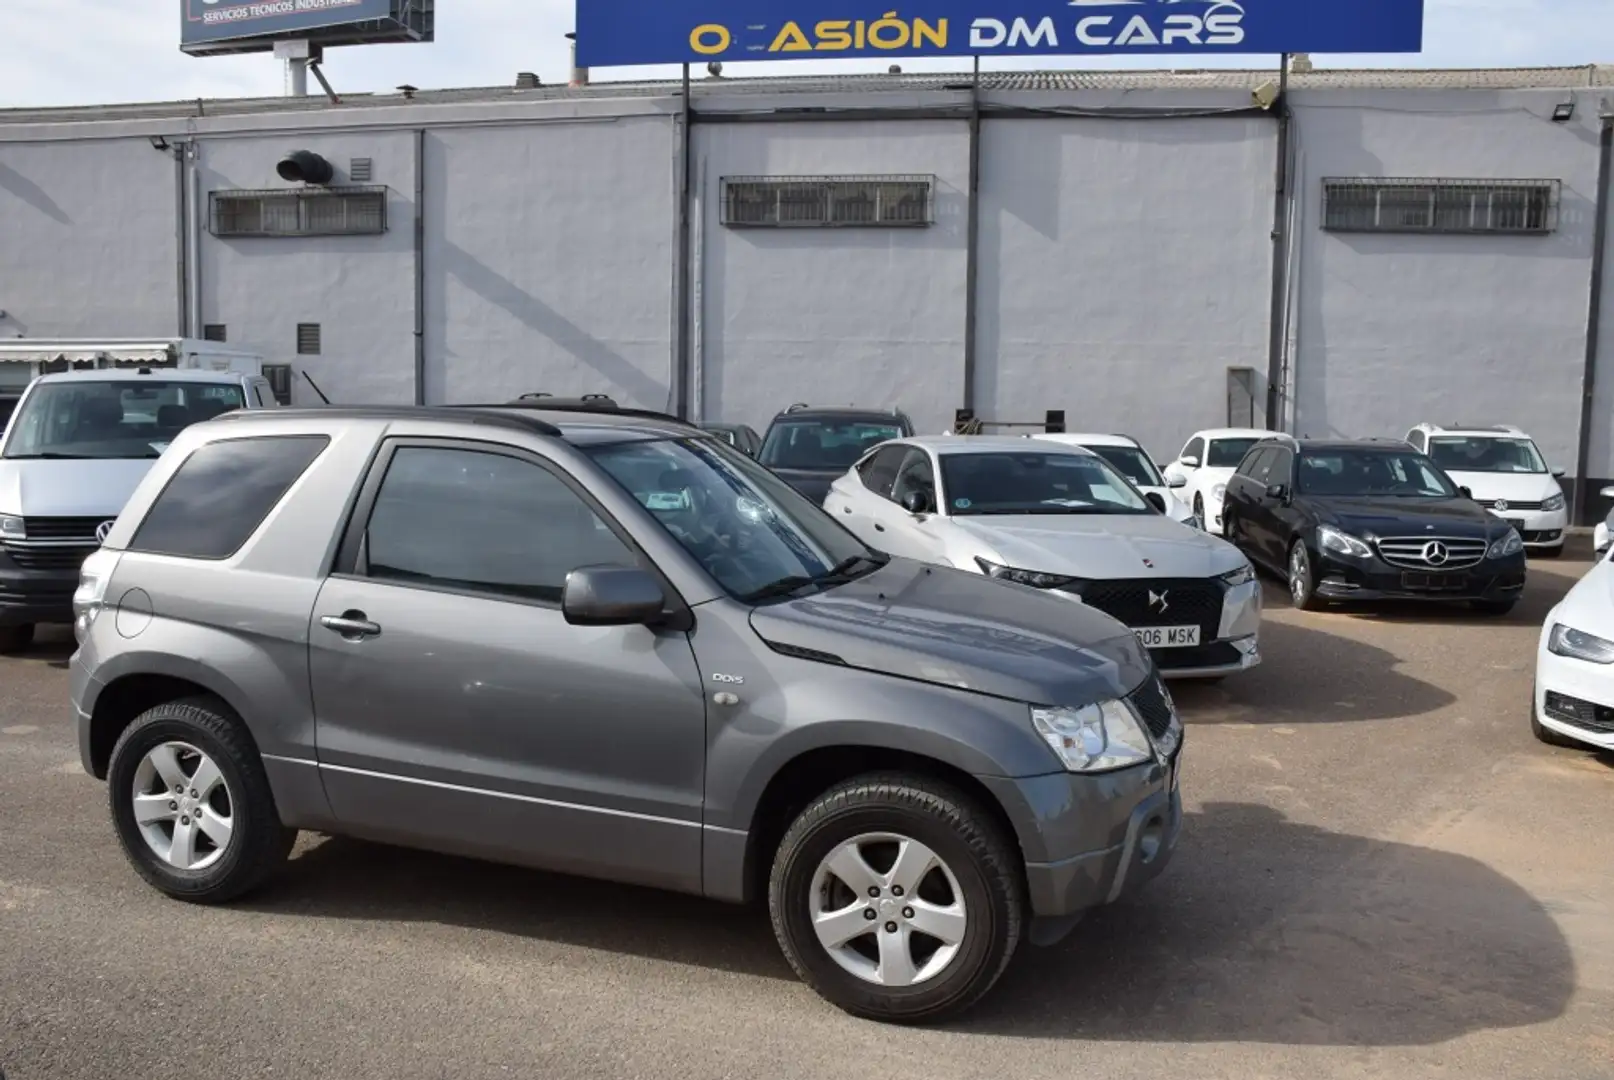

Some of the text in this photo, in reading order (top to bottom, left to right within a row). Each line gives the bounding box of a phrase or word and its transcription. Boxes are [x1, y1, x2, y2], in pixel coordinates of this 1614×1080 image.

[203, 7, 248, 22] SERVICIOS
[295, 0, 357, 10] INDUSTR
[689, 11, 1245, 54] OASIÓN DM CARS
[1168, 627, 1196, 644] MSK
